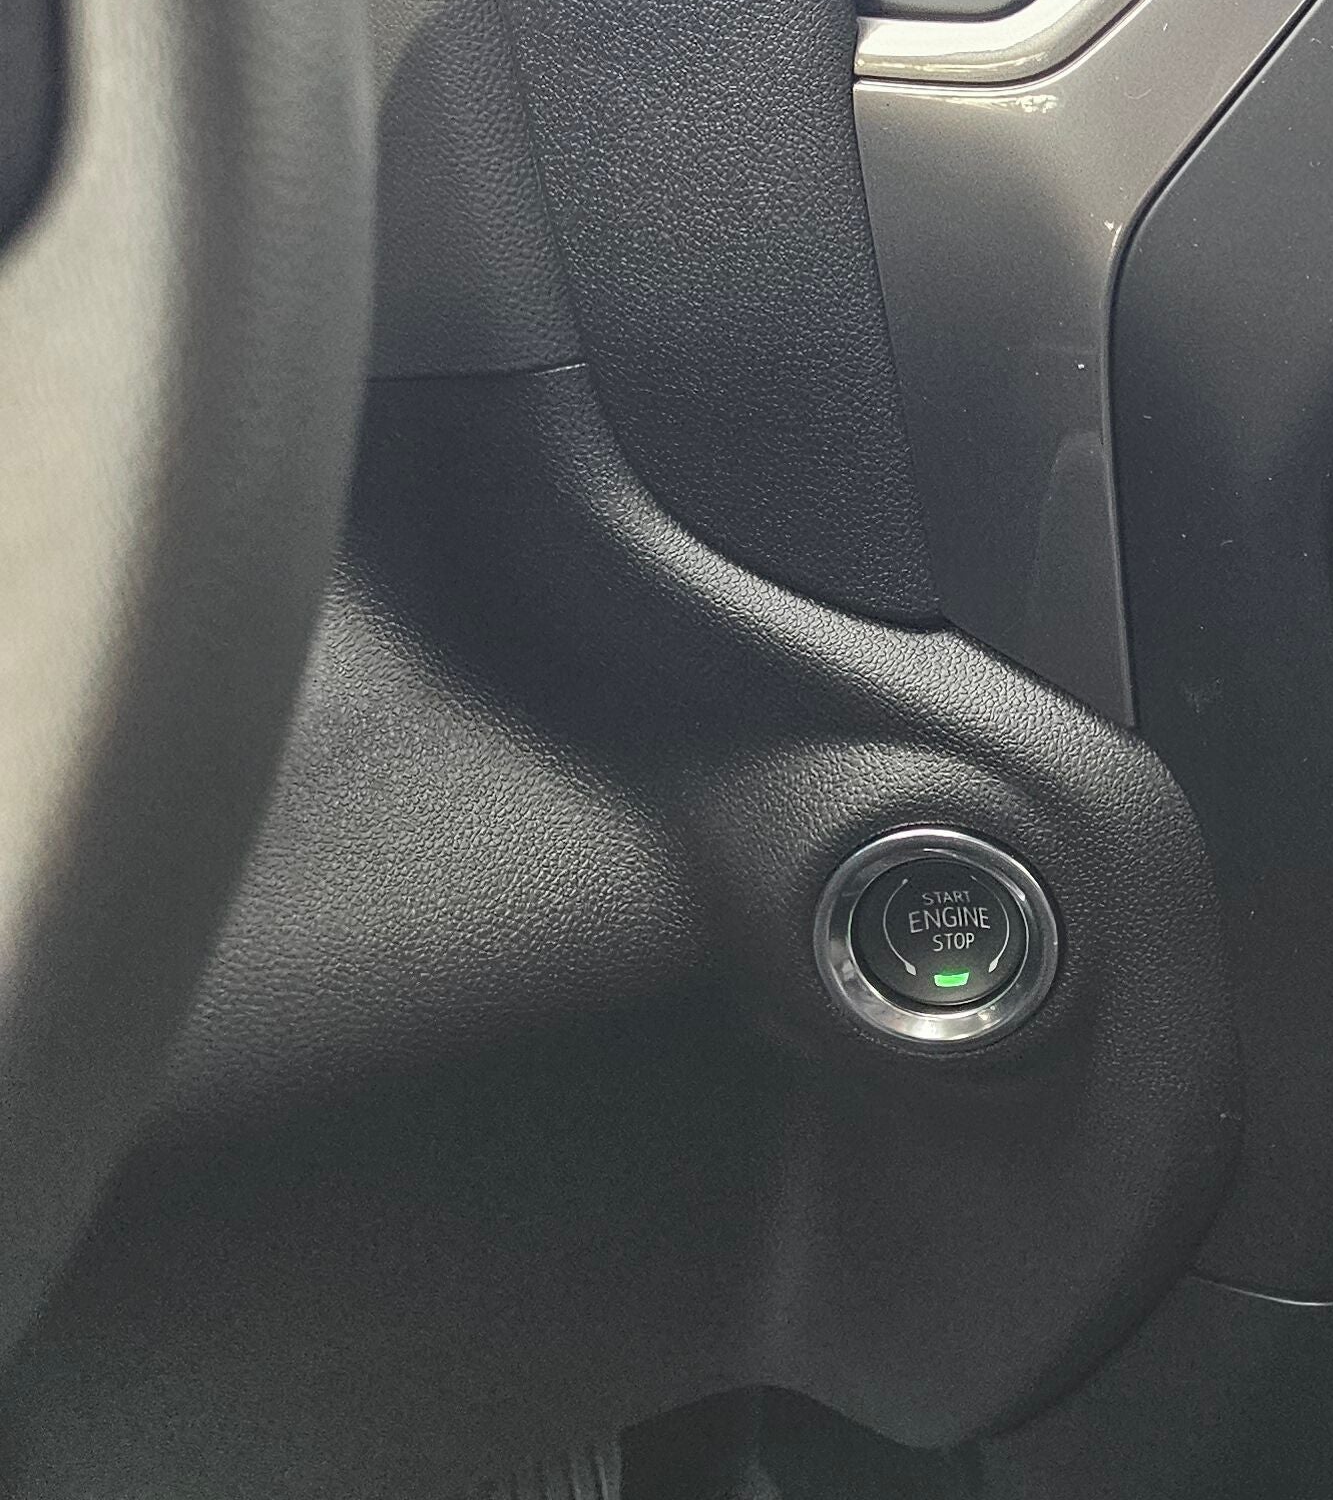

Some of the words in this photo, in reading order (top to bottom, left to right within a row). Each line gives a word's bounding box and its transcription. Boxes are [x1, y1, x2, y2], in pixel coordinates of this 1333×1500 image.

[921, 890, 970, 906] START
[908, 906, 991, 933] ENGINE
[932, 932, 975, 952] STOP
